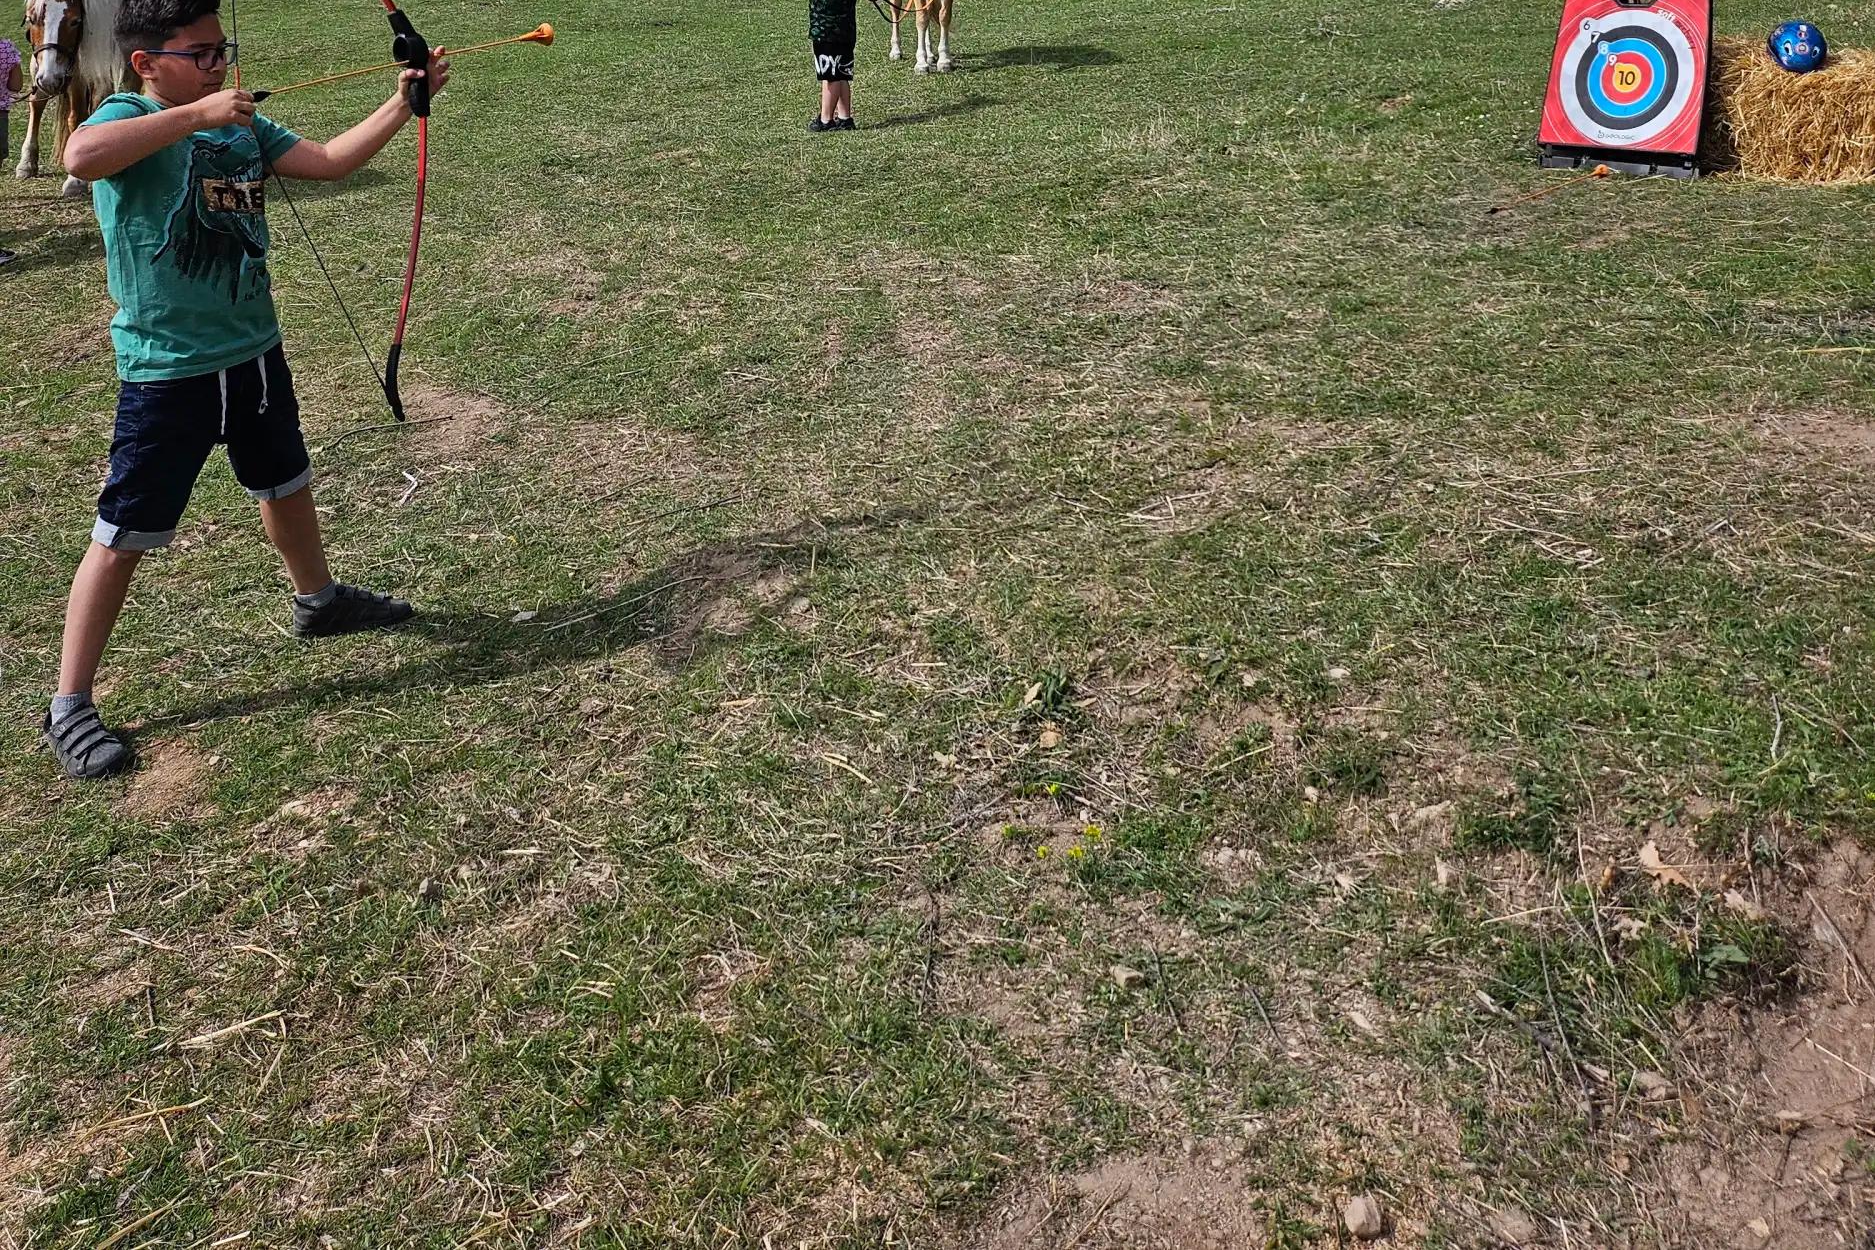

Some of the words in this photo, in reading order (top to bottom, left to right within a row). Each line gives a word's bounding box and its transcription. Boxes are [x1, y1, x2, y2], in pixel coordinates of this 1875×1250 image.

[1583, 20, 1591, 30] 6
[1591, 32, 1600, 44] 7
[1599, 44, 1608, 54] 8
[1608, 55, 1617, 66] 9
[1618, 70, 1635, 86] 10
